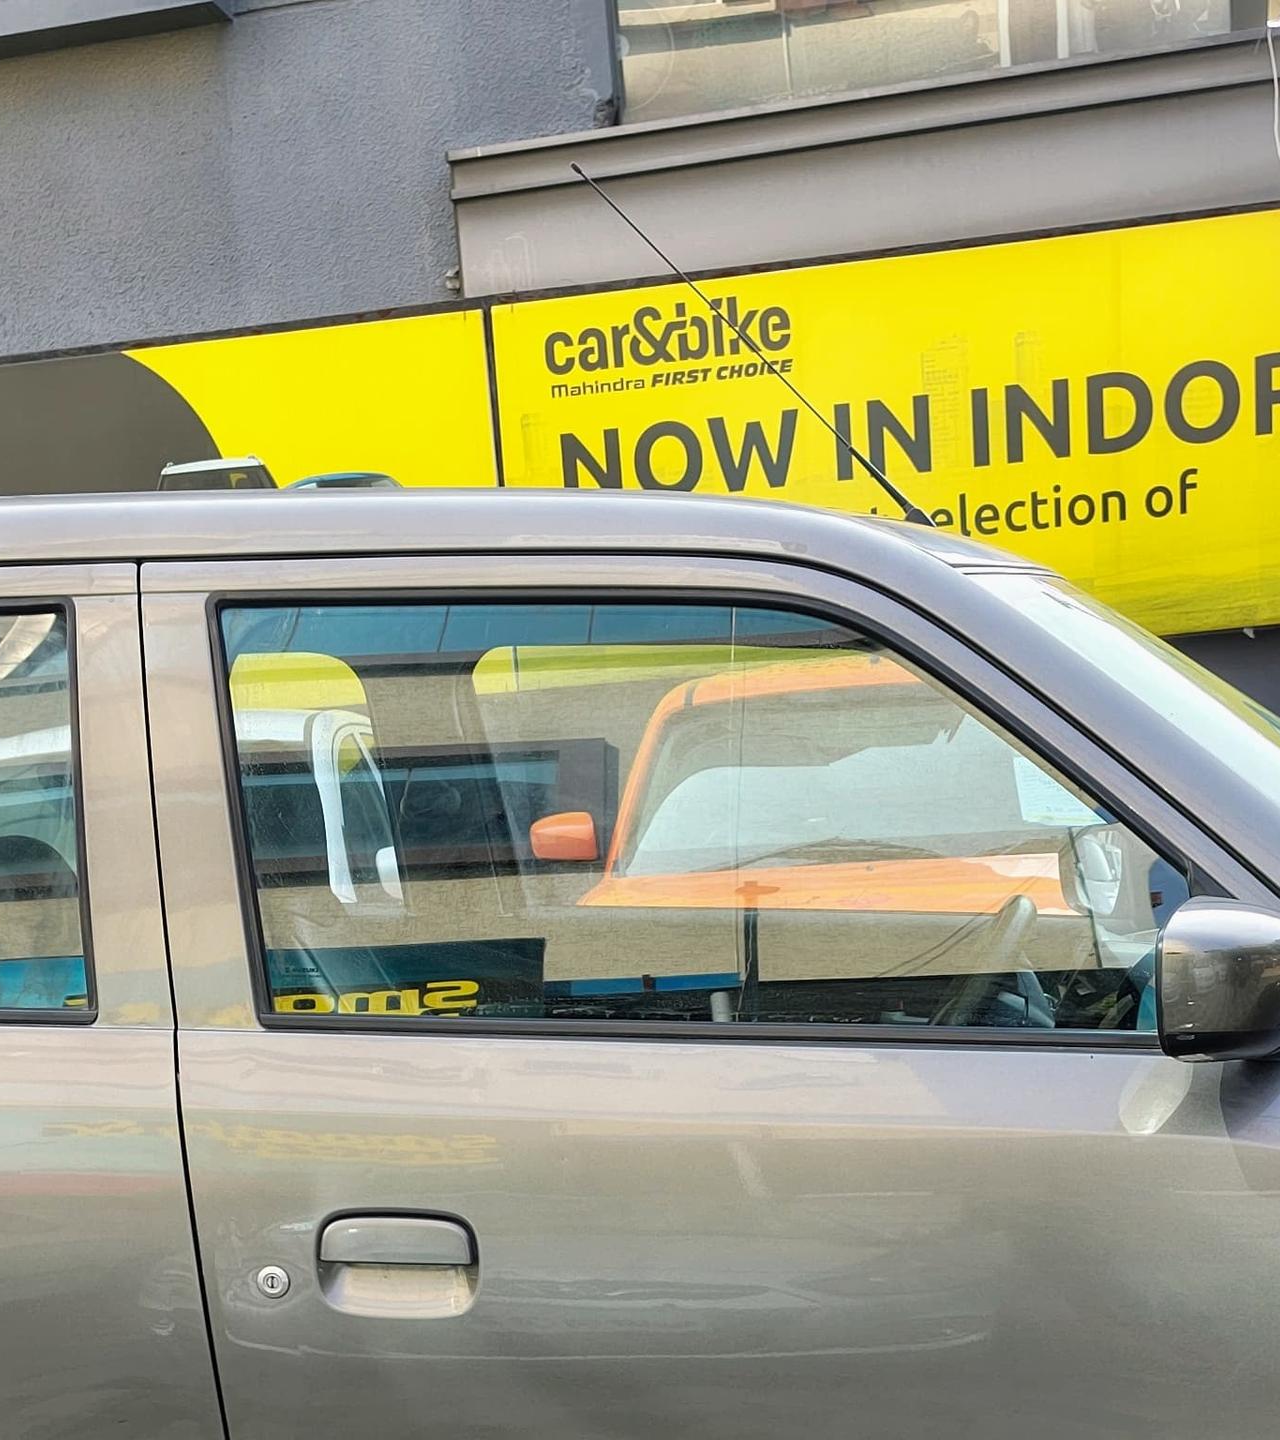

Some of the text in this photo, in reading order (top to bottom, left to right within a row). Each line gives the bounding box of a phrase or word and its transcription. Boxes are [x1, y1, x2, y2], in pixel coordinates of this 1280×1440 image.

[544, 296, 791, 376] car&bike
[551, 359, 793, 398] Mahindra FIRST CHOICE
[560, 408, 798, 492] NOW
[833, 395, 932, 481] IN
[1145, 468, 1199, 518] of
